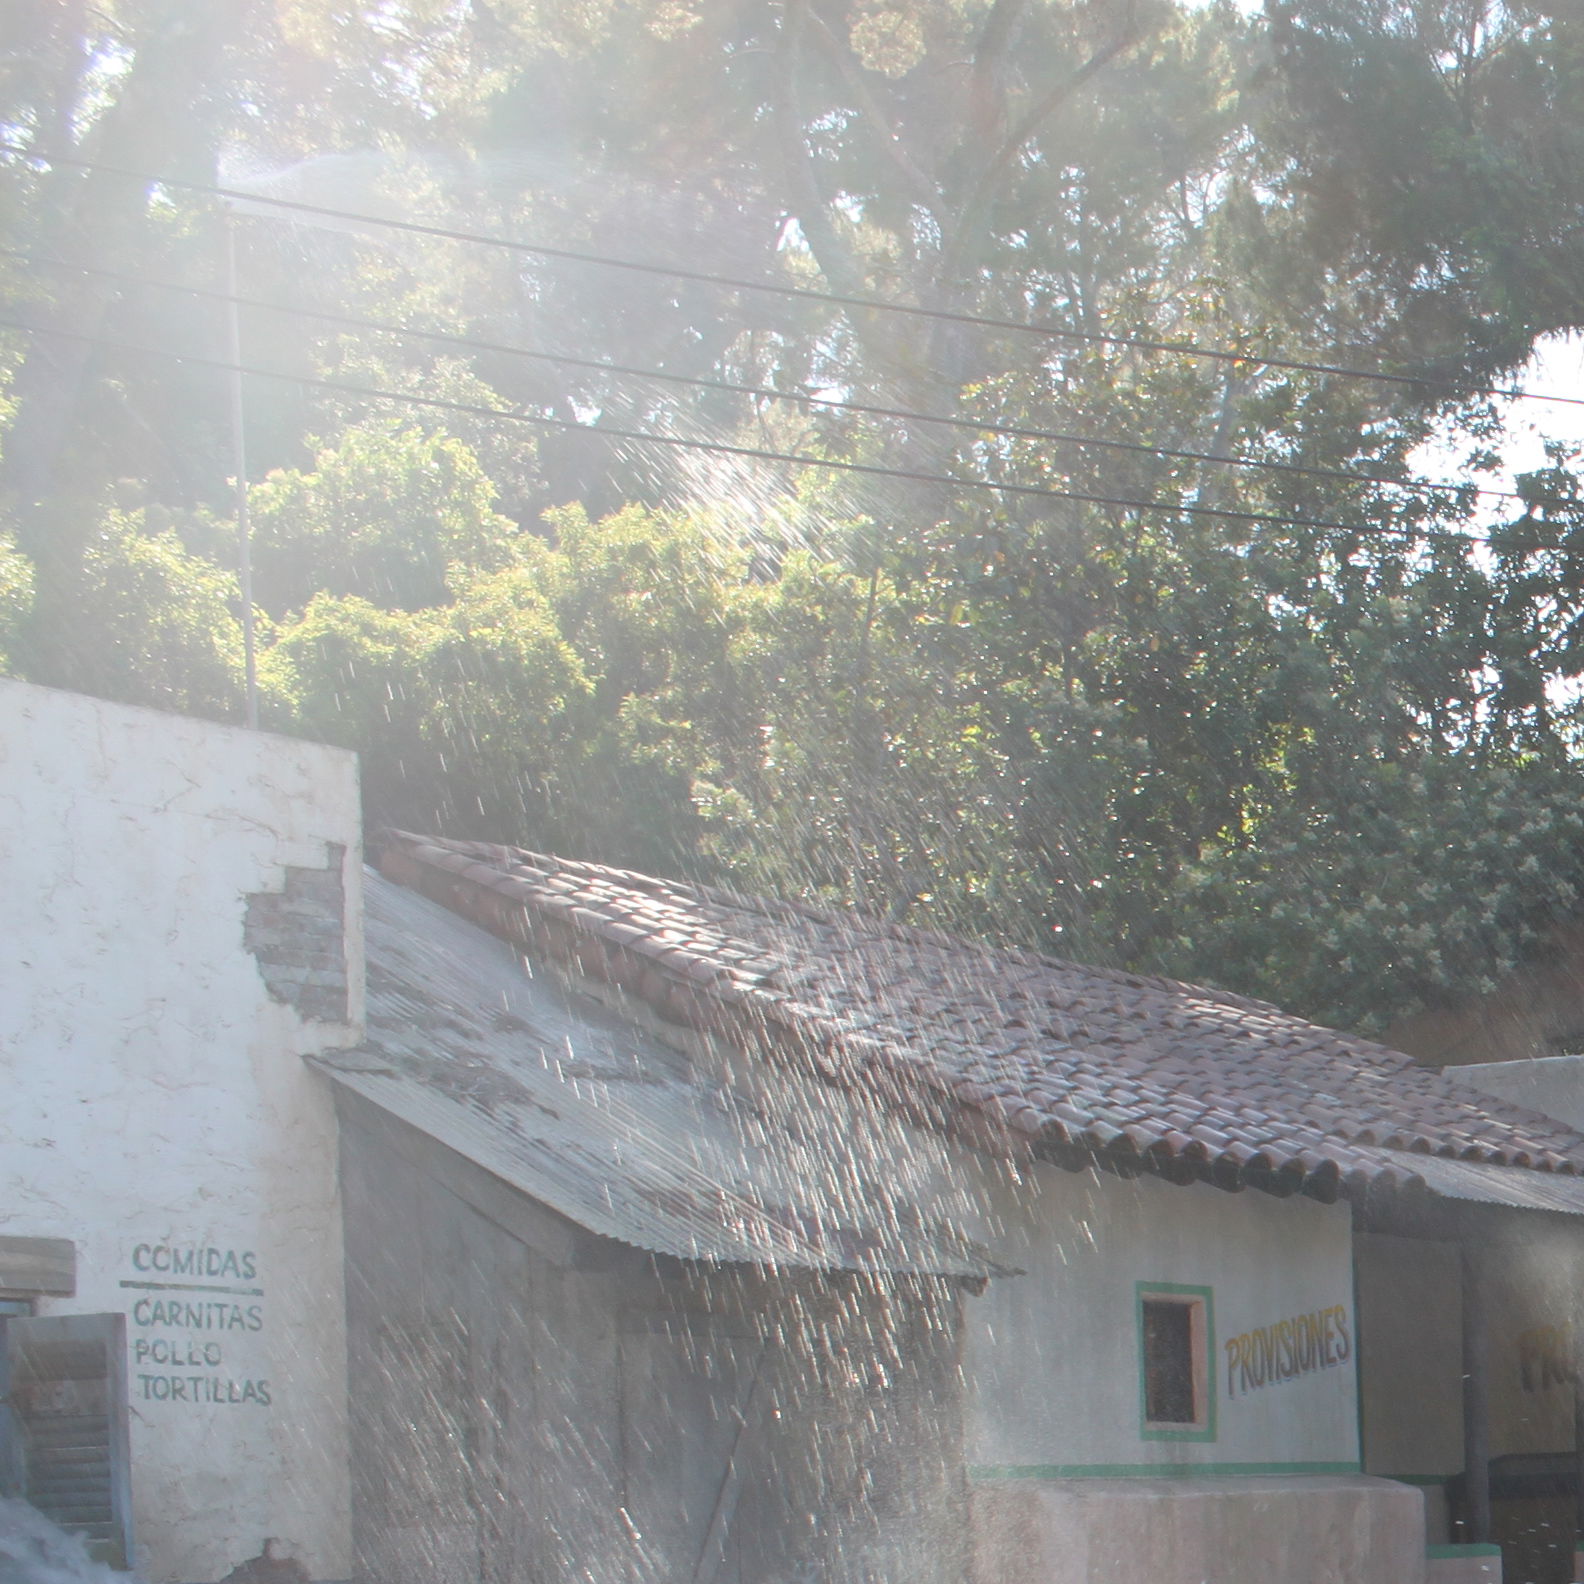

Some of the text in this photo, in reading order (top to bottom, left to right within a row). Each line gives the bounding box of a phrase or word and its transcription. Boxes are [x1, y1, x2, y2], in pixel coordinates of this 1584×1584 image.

[133, 1244, 257, 1279] COMIDAS
[136, 1339, 221, 1366] POLLO
[1224, 1304, 1351, 1400] PROVISIONES
